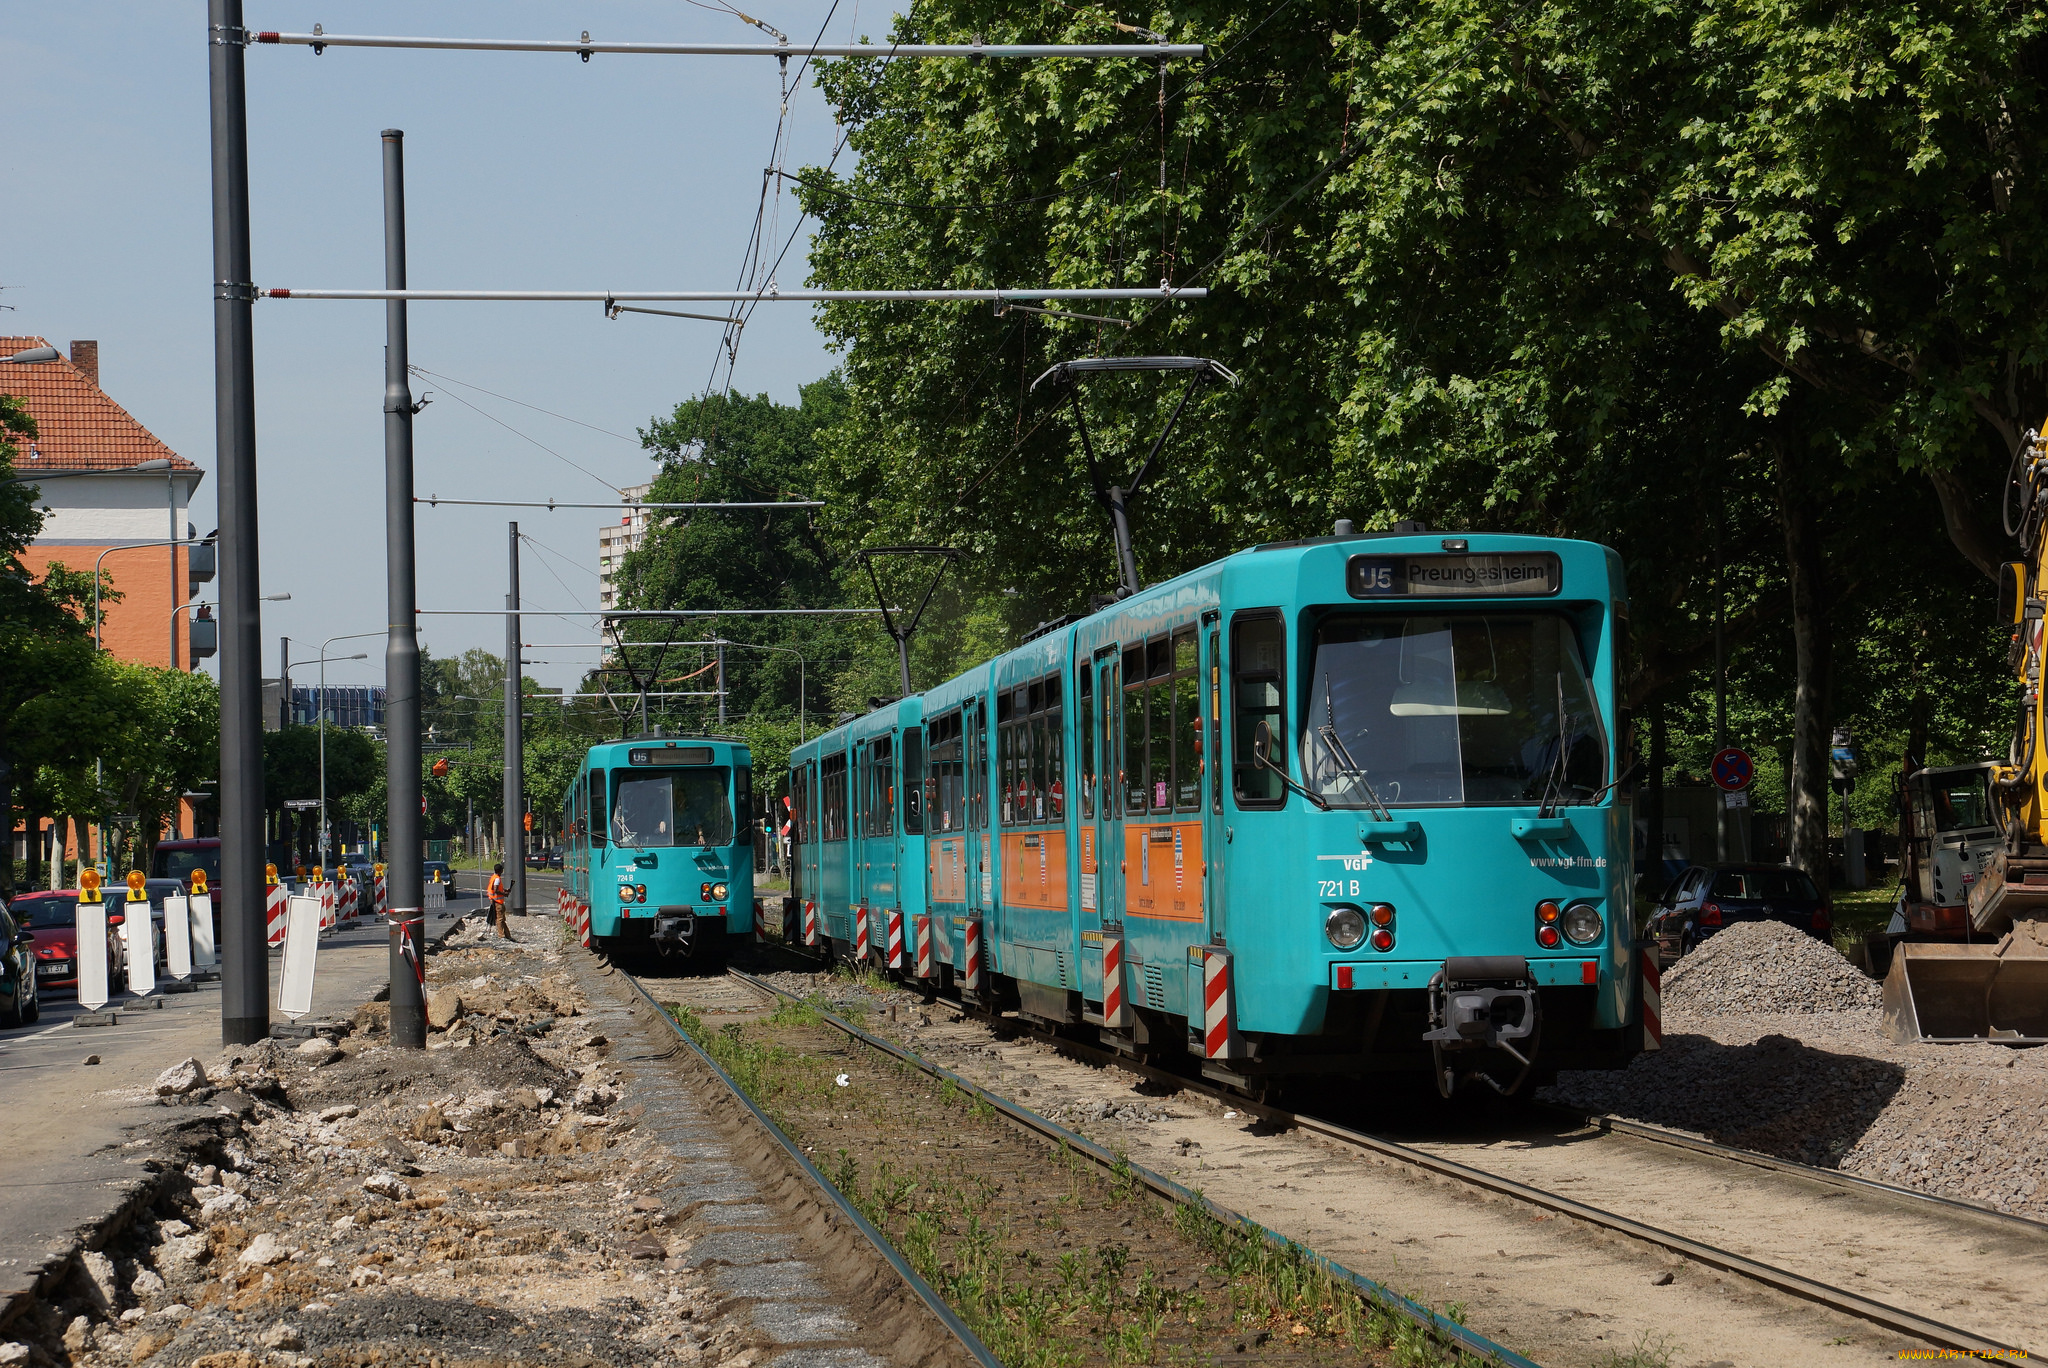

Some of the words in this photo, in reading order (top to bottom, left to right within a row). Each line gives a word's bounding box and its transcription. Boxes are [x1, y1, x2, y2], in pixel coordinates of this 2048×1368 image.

[1359, 567, 1392, 589] U5
[1409, 563, 1544, 583] Preungesheim
[633, 753, 647, 762] U5
[1343, 850, 1373, 871] VGF
[1530, 856, 1607, 869] www.vgf-ffm.de
[617, 874, 628, 882] 724
[628, 874, 634, 882] B
[1317, 880, 1343, 897] 721
[1350, 880, 1360, 897] B
